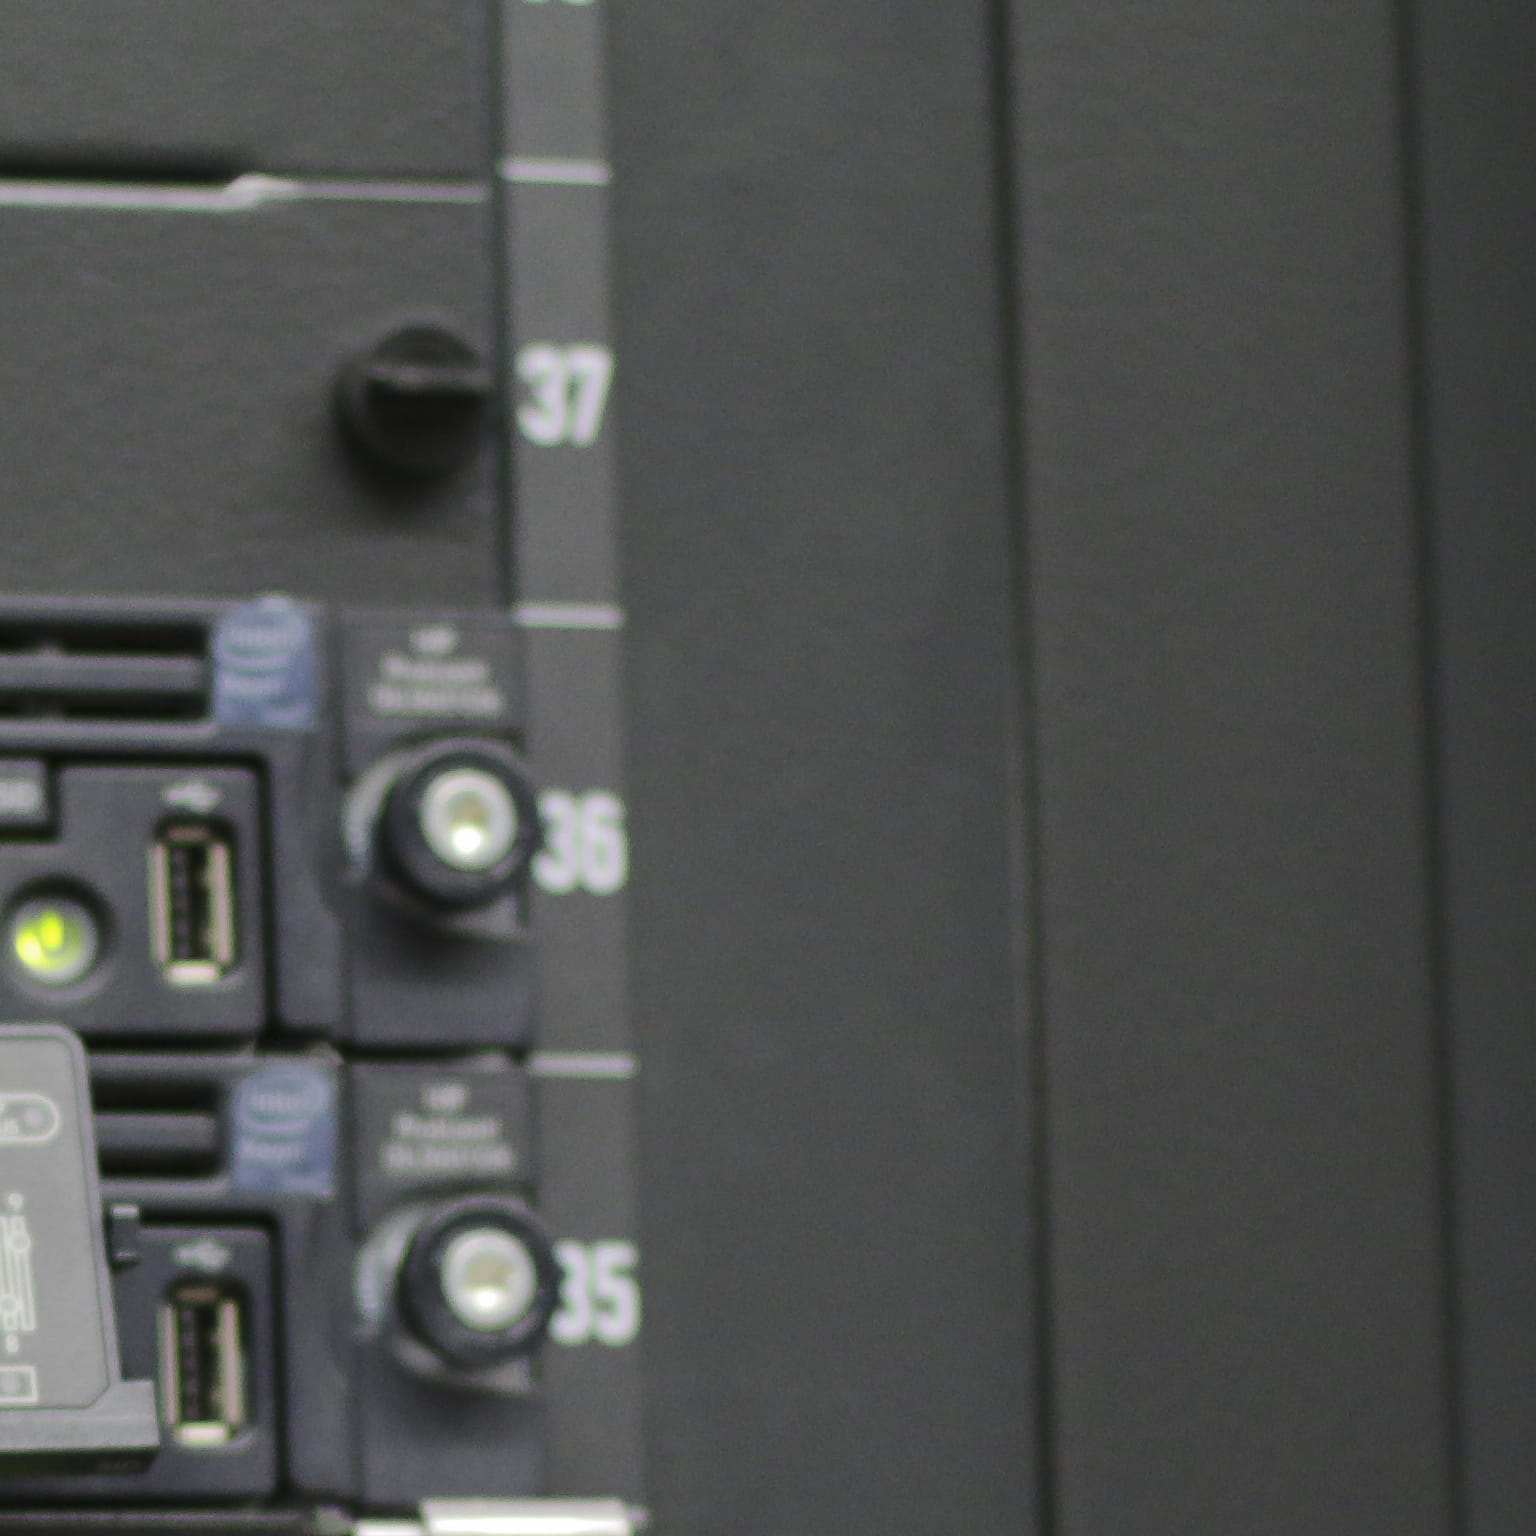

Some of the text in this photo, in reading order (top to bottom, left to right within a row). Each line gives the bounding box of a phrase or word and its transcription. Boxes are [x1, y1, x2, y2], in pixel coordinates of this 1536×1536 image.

[516, 343, 614, 446] 37
[533, 791, 627, 894] 36
[8, 1193, 23, 1211] 9
[551, 1241, 640, 1345] 35
